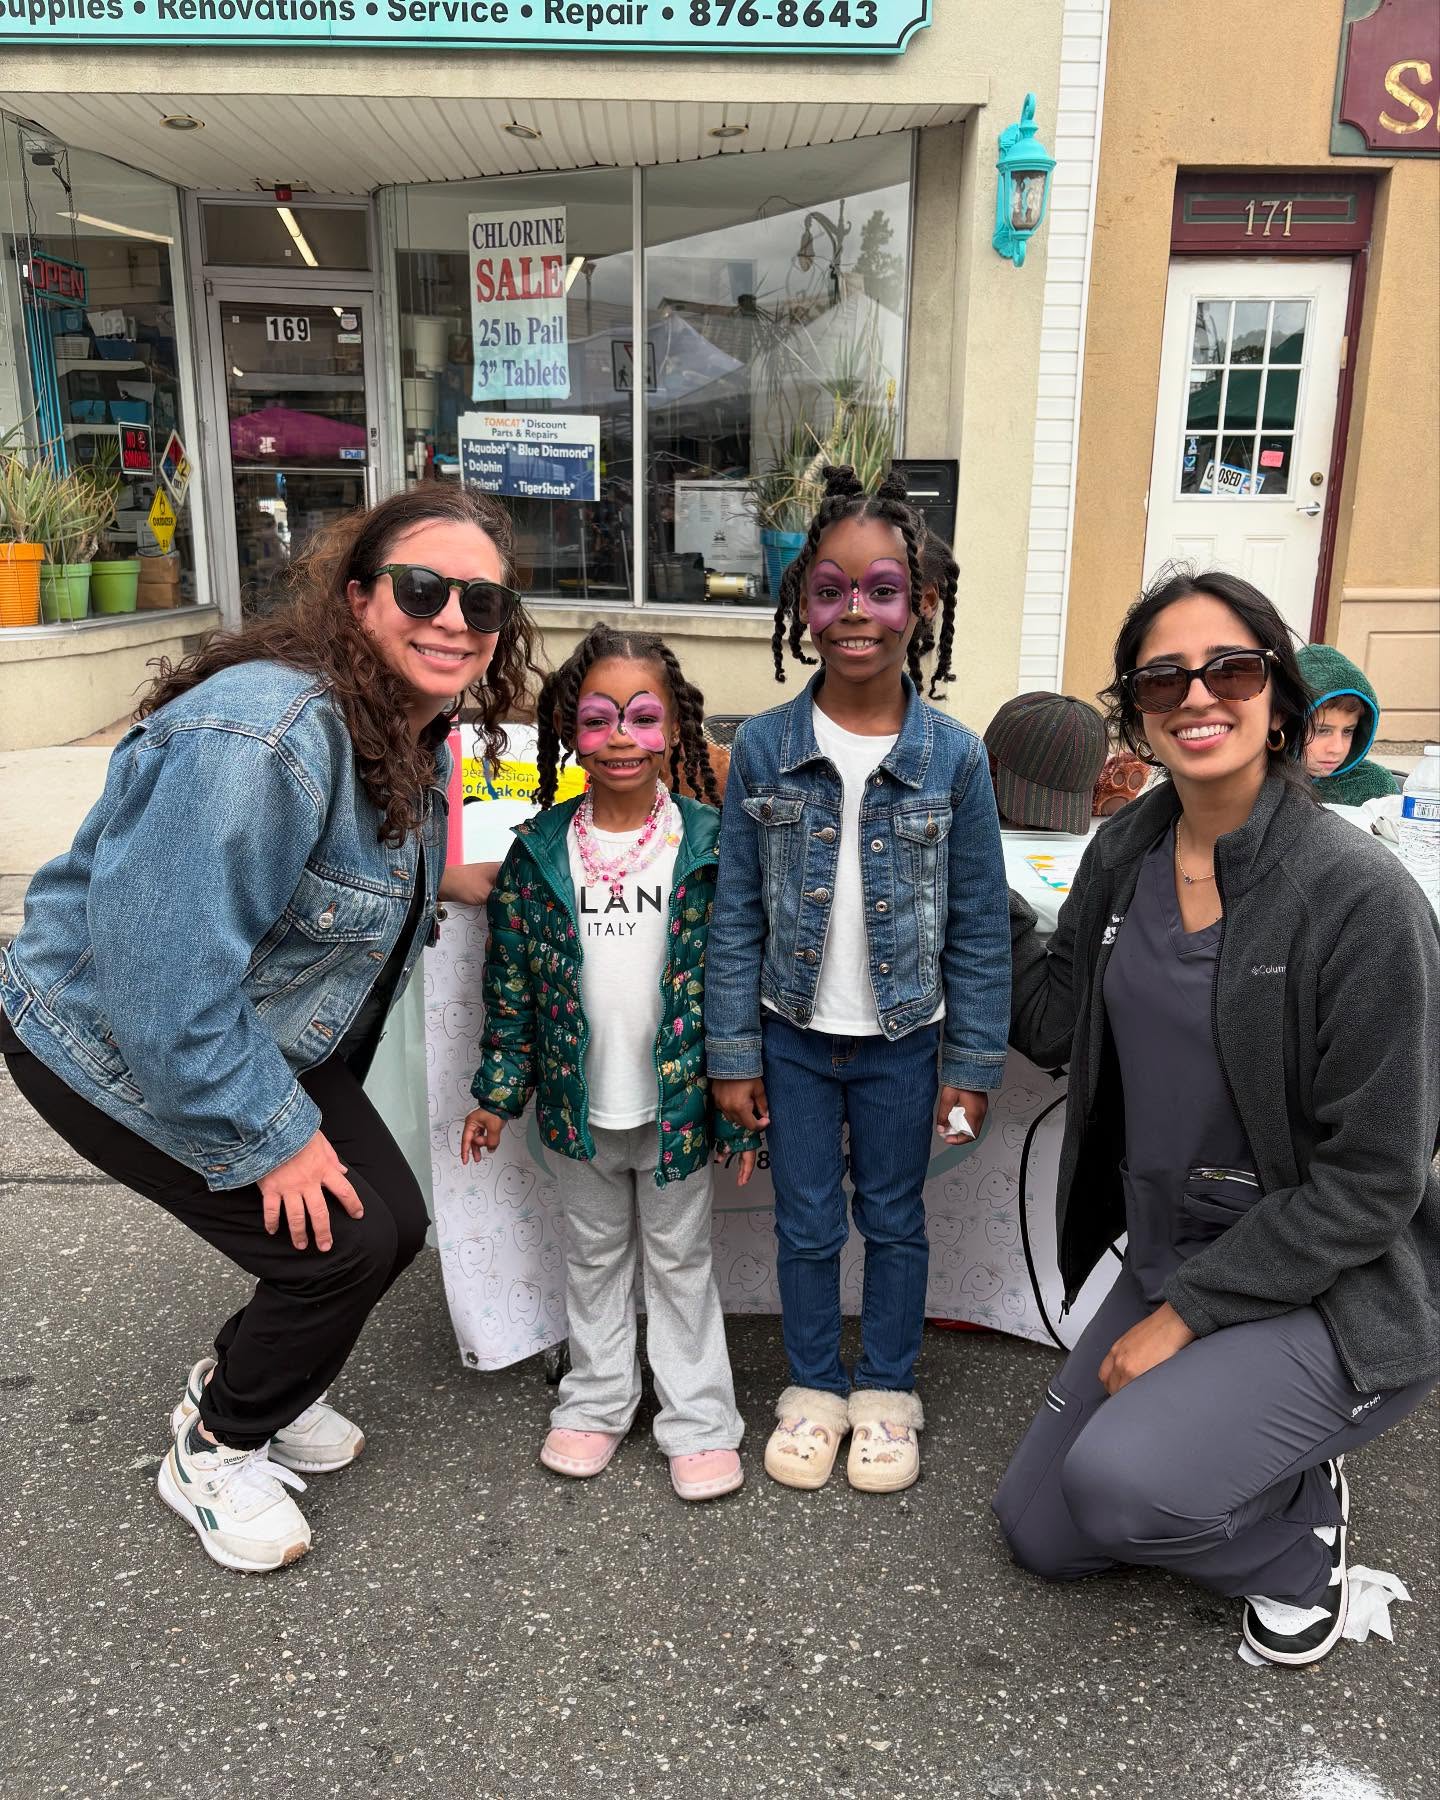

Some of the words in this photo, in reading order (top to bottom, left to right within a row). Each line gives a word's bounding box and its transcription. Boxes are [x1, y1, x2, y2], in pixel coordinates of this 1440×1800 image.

[158, 0, 355, 20] Renovations
[388, 0, 508, 23] Service
[545, 0, 648, 31] Repair
[689, 0, 878, 28] 876-8643
[1378, 59, 1440, 134] S
[1245, 200, 1293, 236] 171
[472, 218, 565, 249] CHLORINE
[29, 258, 85, 299] OPEN
[476, 255, 564, 303] SALE
[270, 318, 309, 341] 169
[479, 319, 501, 347] 25
[505, 322, 522, 345] lb
[527, 316, 564, 344] Pail
[502, 359, 567, 387] Tablets
[492, 428, 513, 438] Parts
[516, 429, 522, 437] &
[525, 430, 558, 440] Repairs
[527, 419, 567, 430] Discount
[518, 444, 539, 457] Blue
[468, 459, 503, 473] Dolphin
[1207, 465, 1242, 487] COSED
[463, 784, 473, 794] o
[476, 782, 513, 797] frak
[588, 922, 636, 936] ITALY
